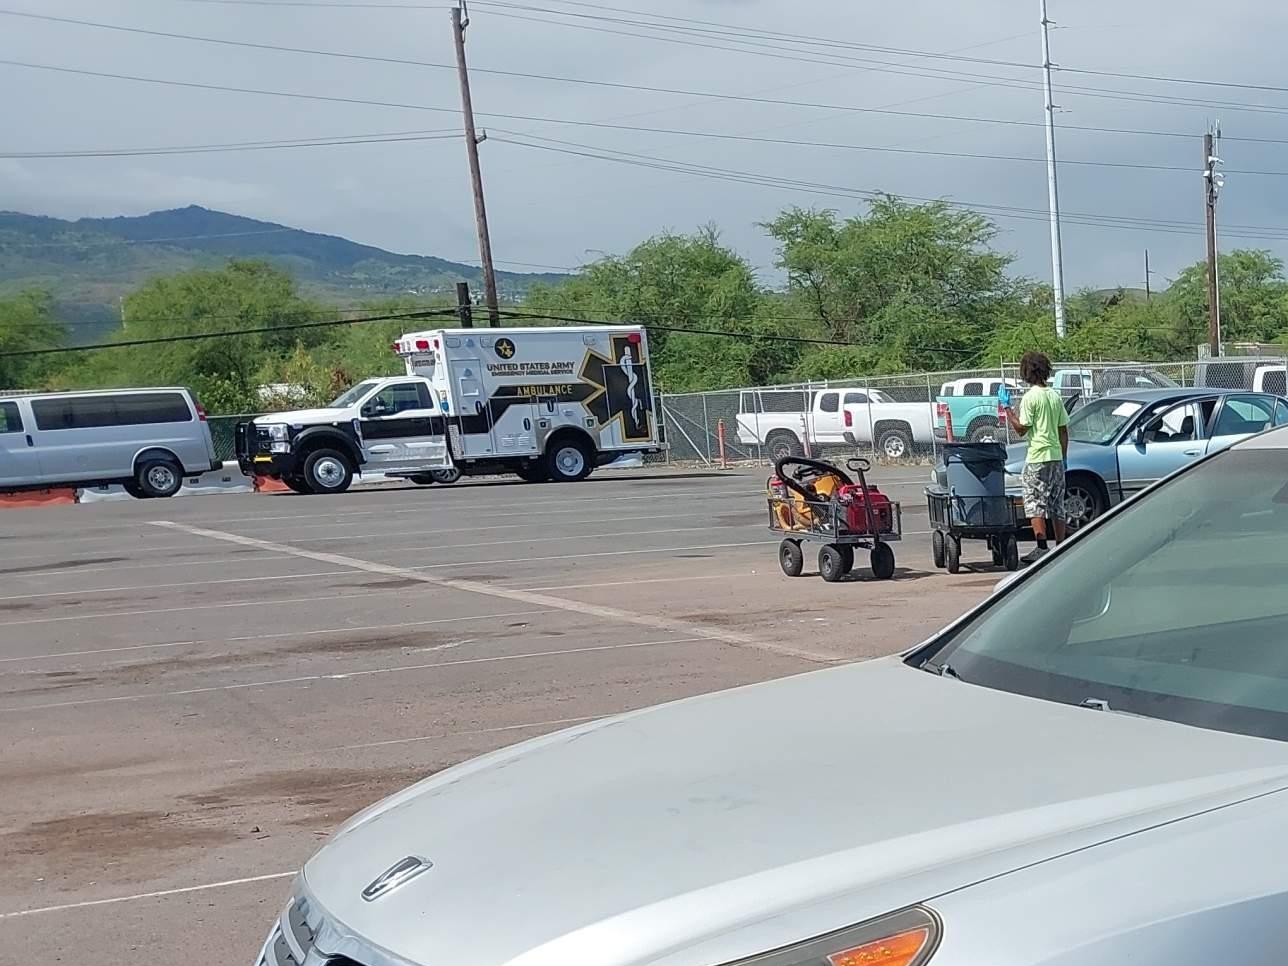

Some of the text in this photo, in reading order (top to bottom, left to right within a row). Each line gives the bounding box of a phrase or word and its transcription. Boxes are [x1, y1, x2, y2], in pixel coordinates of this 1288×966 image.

[487, 361, 575, 372] UNITED STATES ARMY
[517, 384, 573, 396] AMBULANCE
